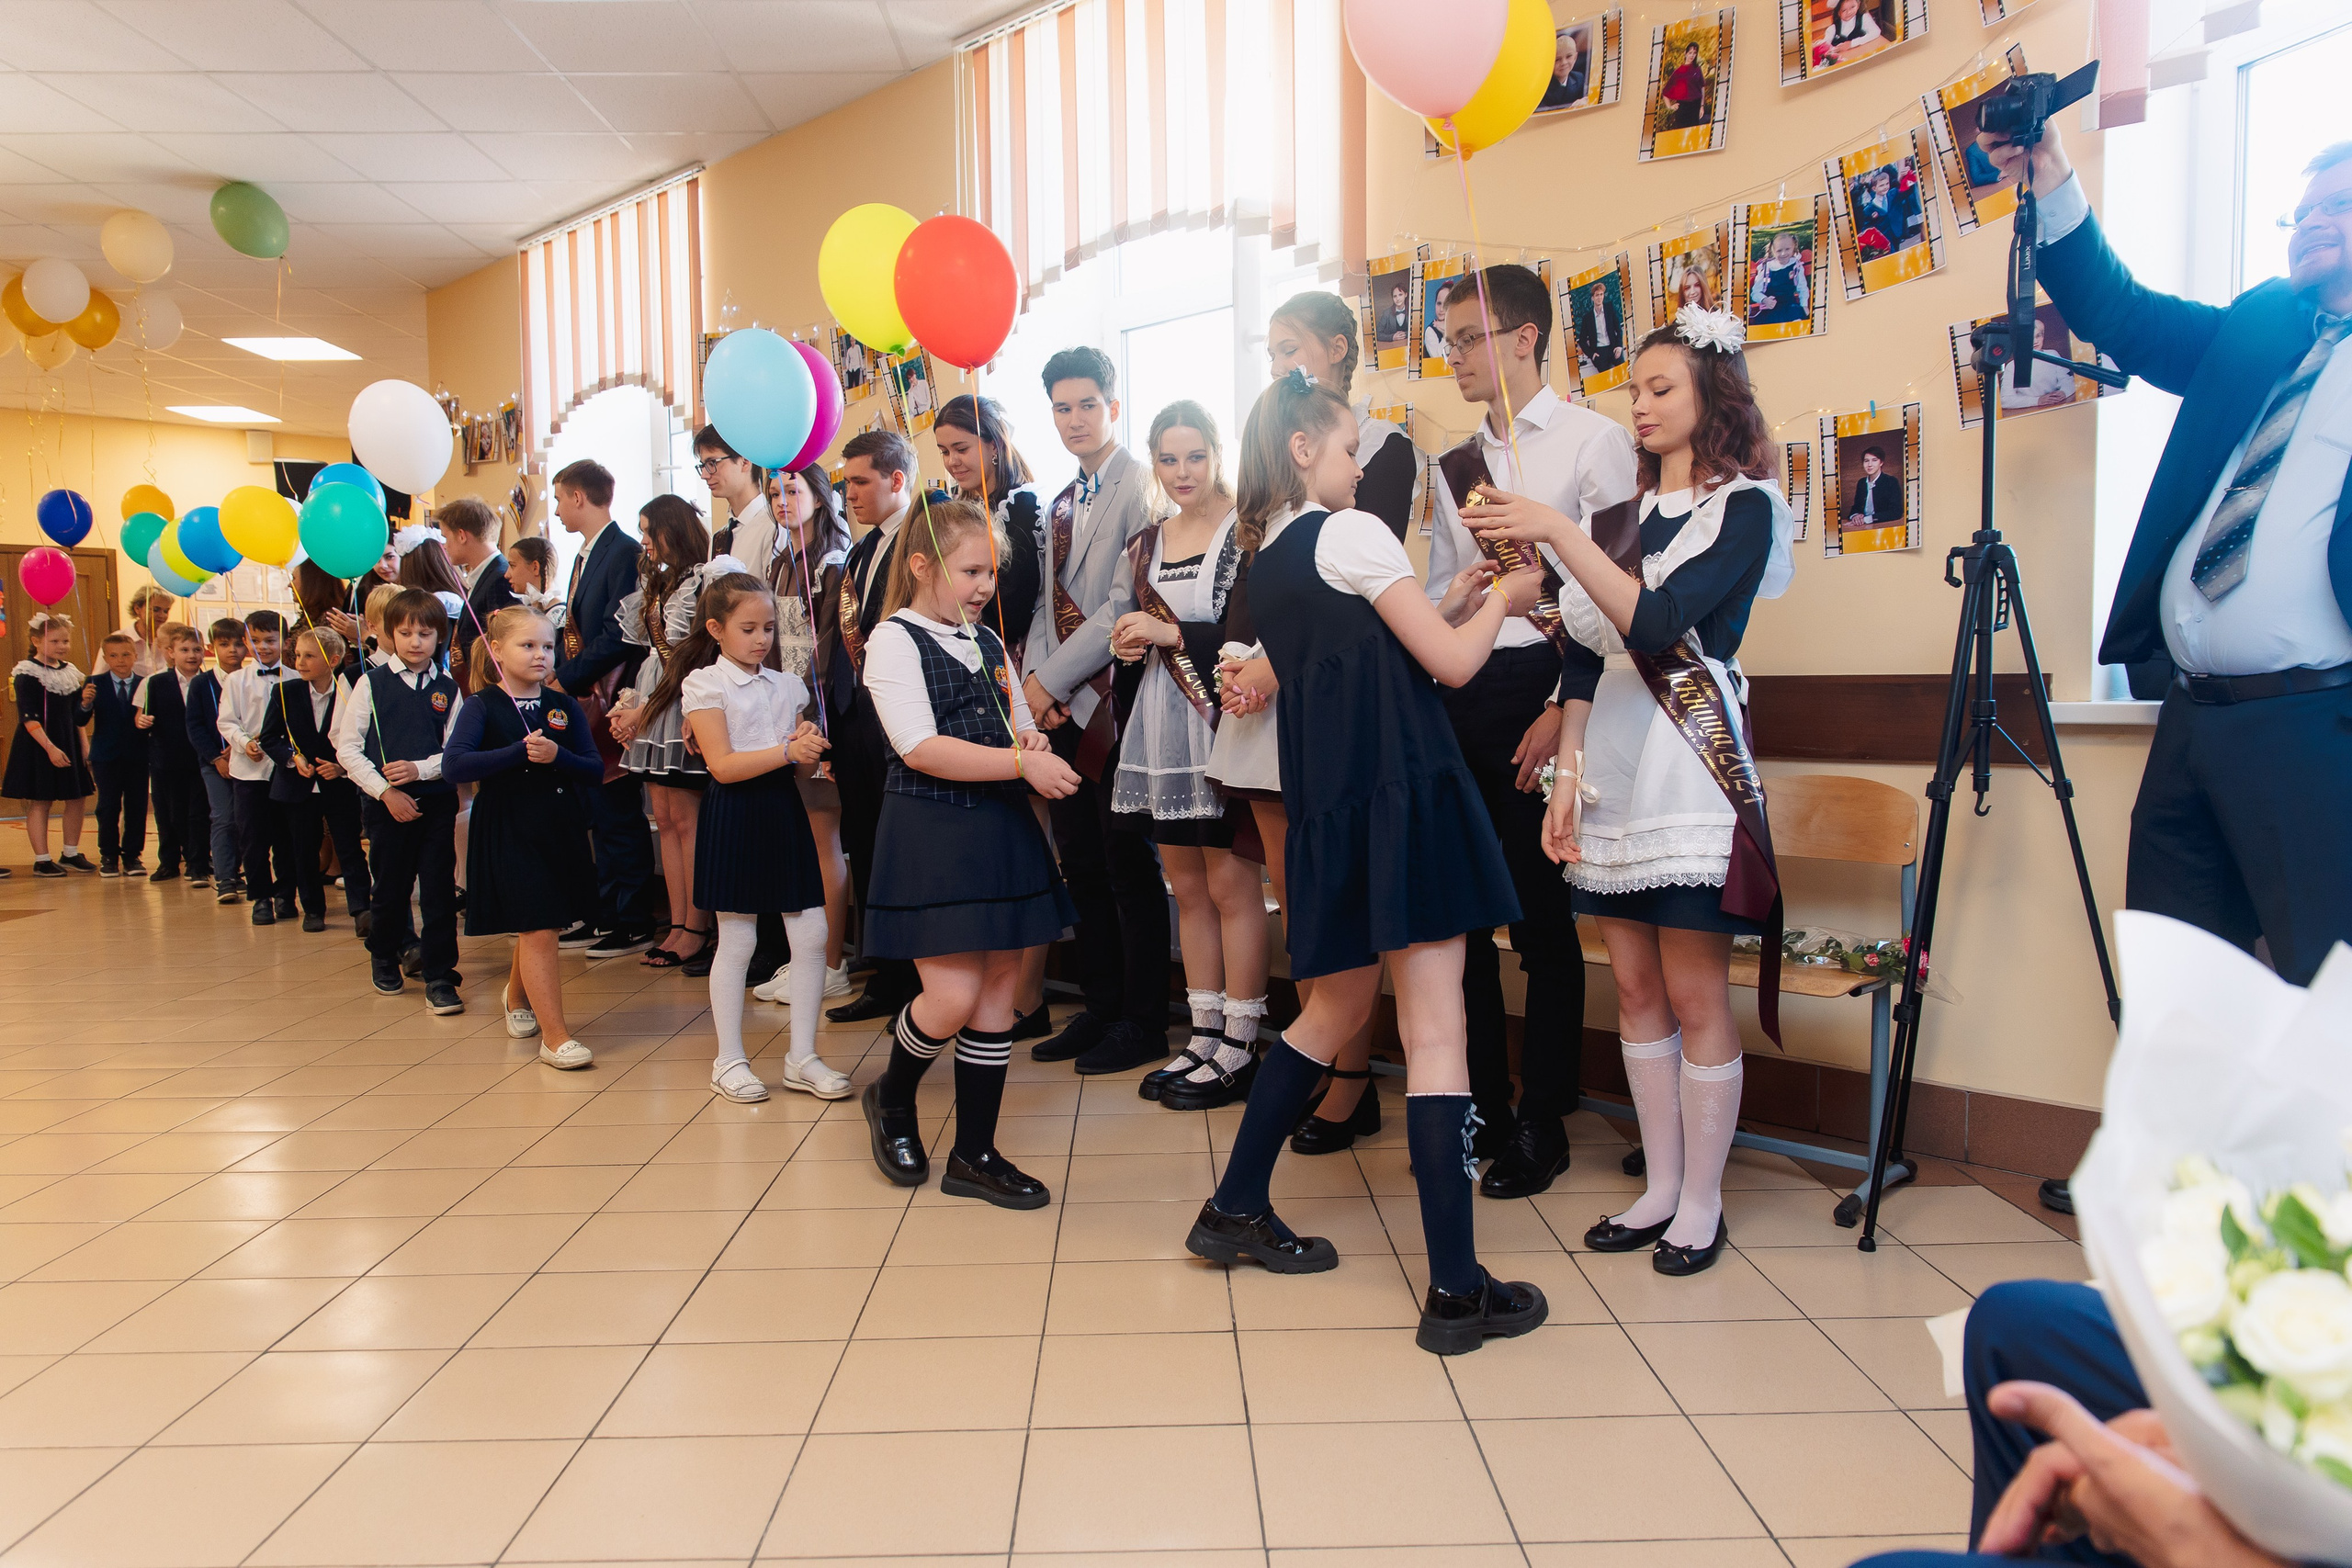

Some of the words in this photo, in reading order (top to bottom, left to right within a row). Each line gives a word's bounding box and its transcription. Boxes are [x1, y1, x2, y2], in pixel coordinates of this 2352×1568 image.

[2023, 245, 2031, 270] LUMIX
[1059, 604, 1086, 635] 202
[1696, 742, 1730, 790] Кронштадт
[1717, 747, 1765, 805] 2024
